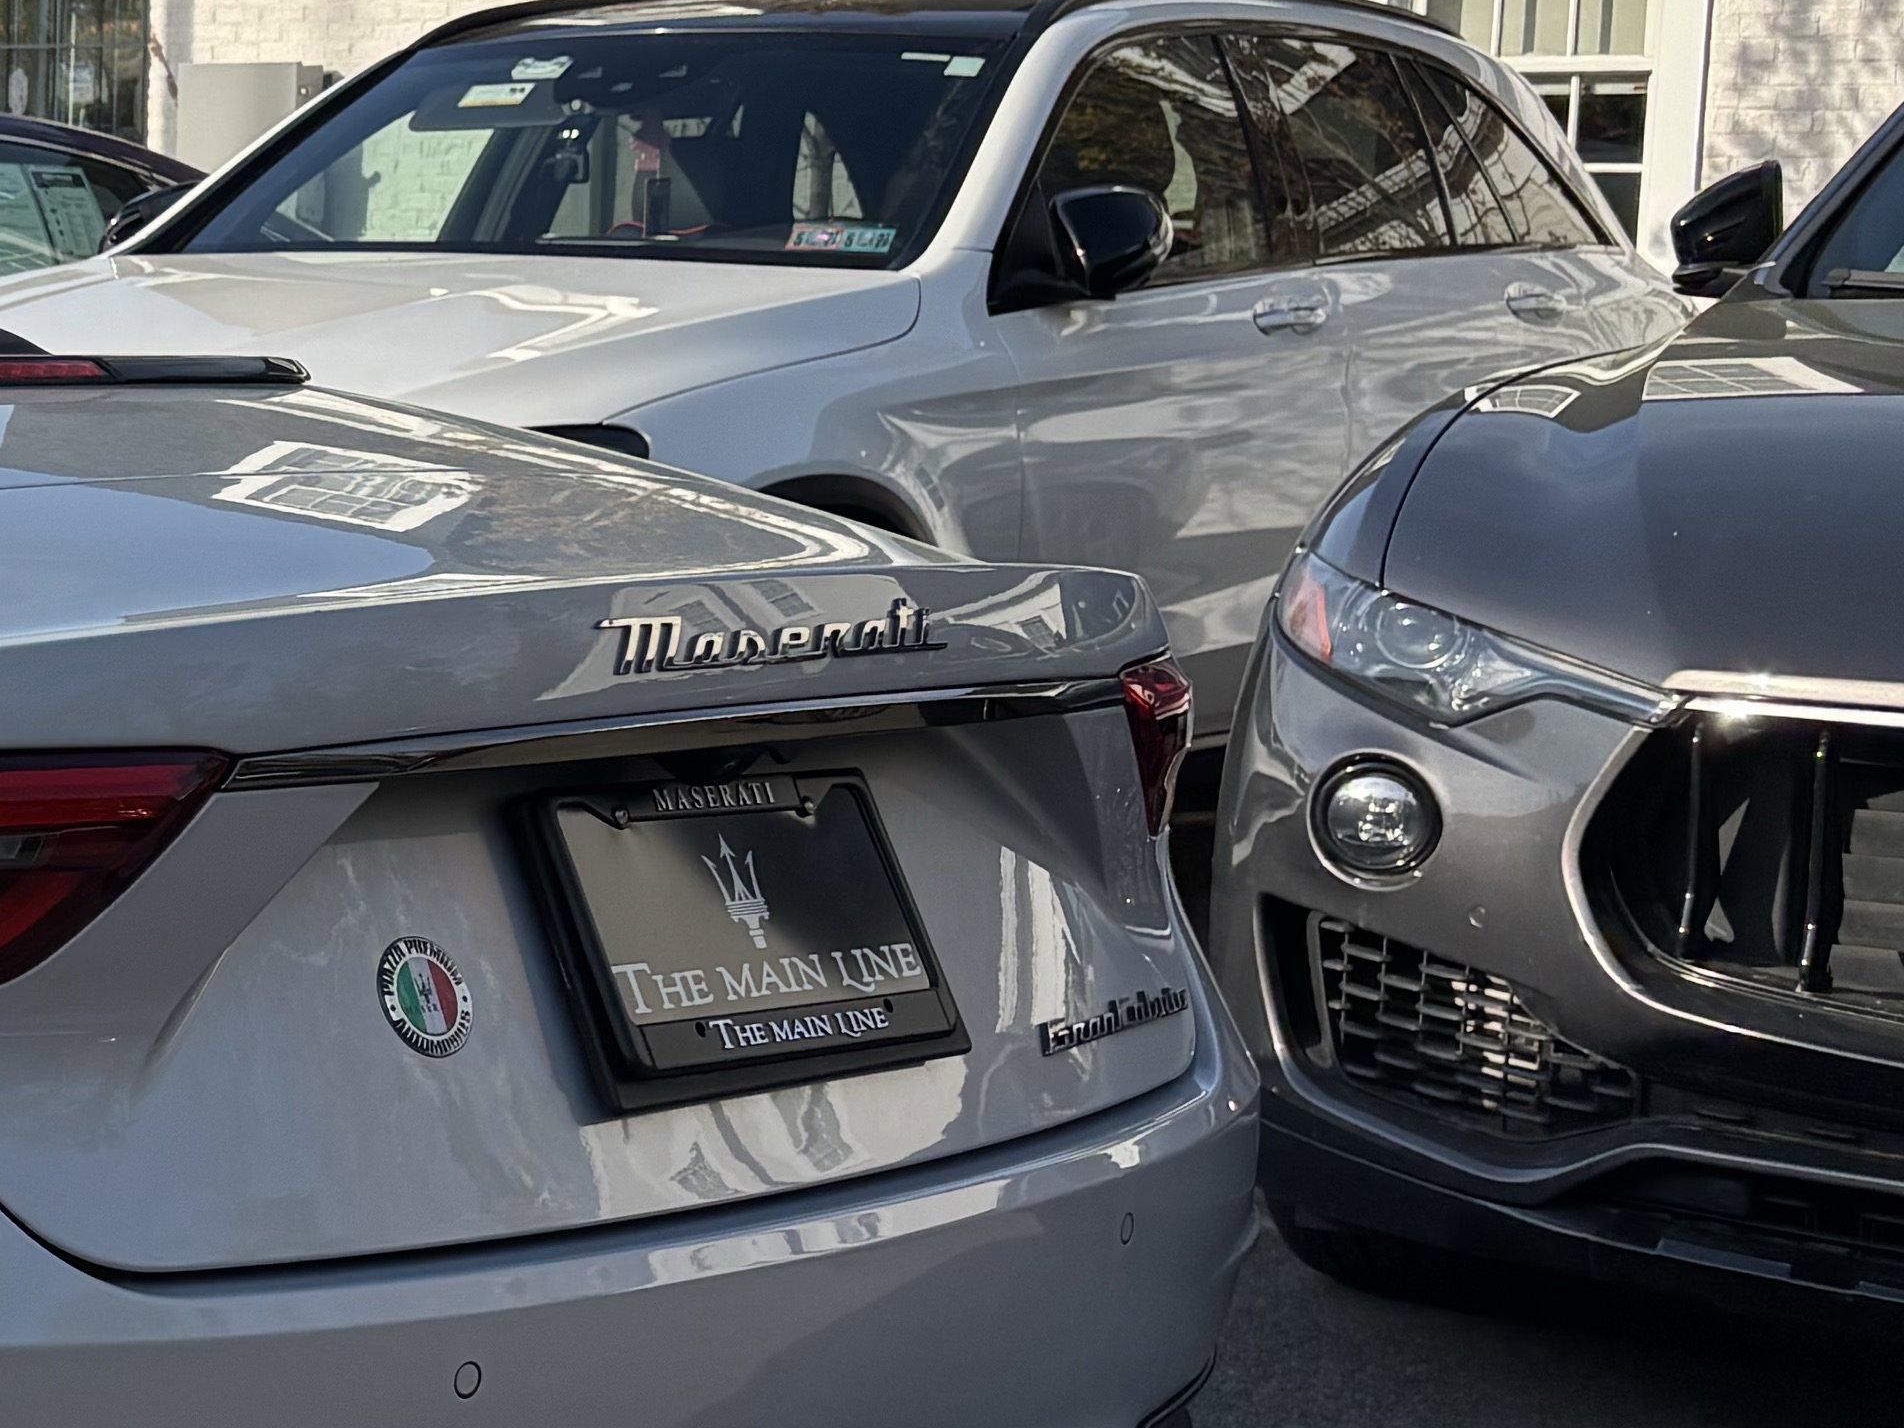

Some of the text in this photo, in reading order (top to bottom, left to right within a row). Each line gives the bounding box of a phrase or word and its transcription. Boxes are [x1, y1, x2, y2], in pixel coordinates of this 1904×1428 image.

[592, 598, 948, 676] Maserati
[652, 781, 776, 812] MASERATI
[610, 942, 922, 1015] THE MAIN LINE
[708, 1006, 889, 1050] THE MAIN LINE
